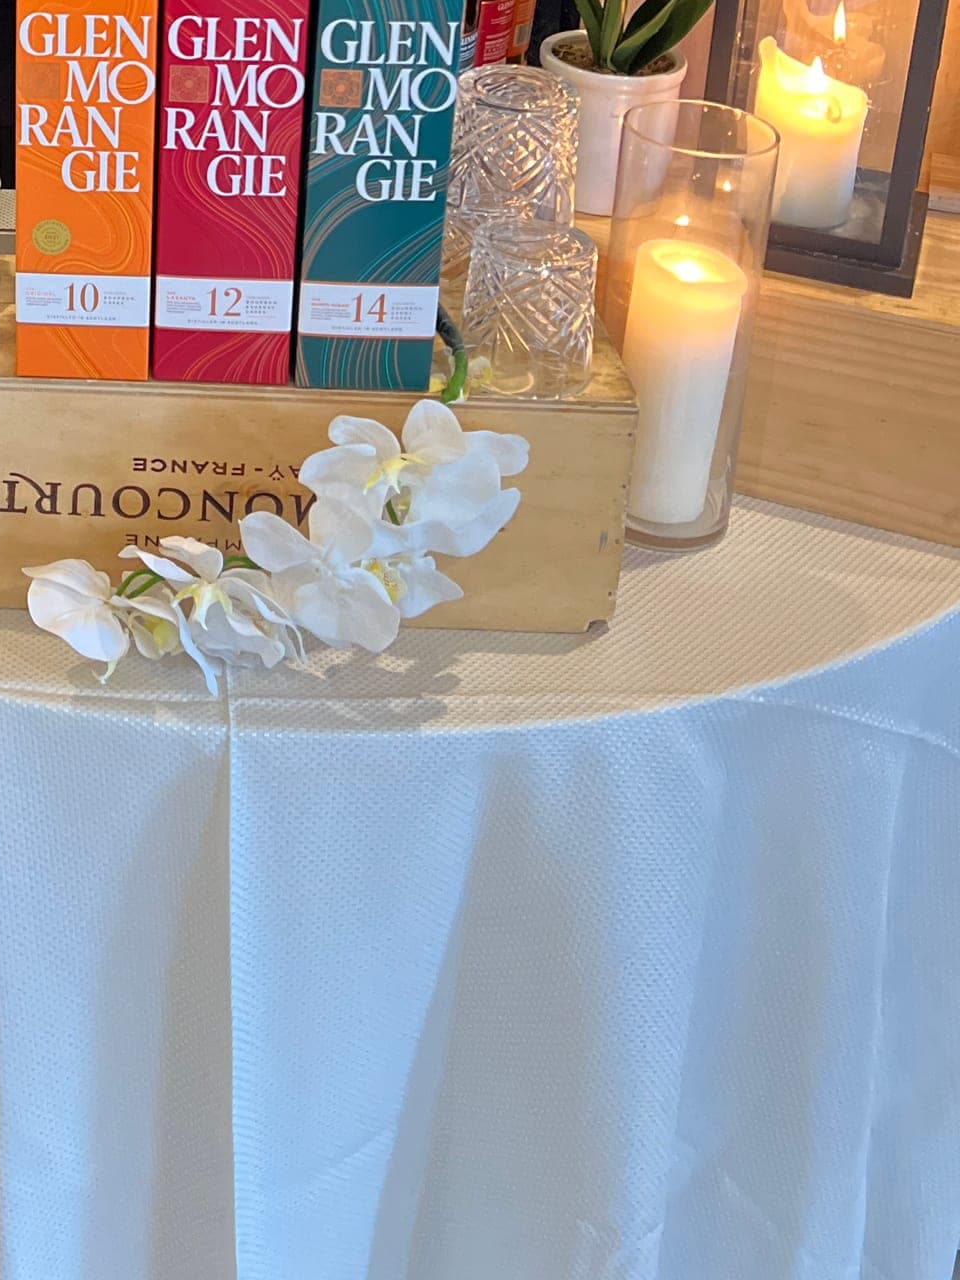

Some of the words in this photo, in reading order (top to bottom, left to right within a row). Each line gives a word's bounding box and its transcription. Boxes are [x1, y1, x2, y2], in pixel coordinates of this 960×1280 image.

[19, 12, 152, 60] GLEN
[167, 15, 305, 63] GLEN
[320, 18, 461, 67] GLEN
[64, 60, 156, 106] MO
[213, 64, 306, 109] MO
[365, 68, 458, 113] MO
[18, 104, 122, 148] RAN
[163, 108, 271, 153] RAN
[313, 112, 422, 157] RAN
[61, 150, 141, 193] GIE
[206, 154, 288, 197] GIE
[356, 159, 437, 201] GIE
[64, 282, 99, 312] 10
[205, 287, 242, 317] 12
[352, 293, 387, 323] 14
[132, 457, 246, 476] FRANCE
